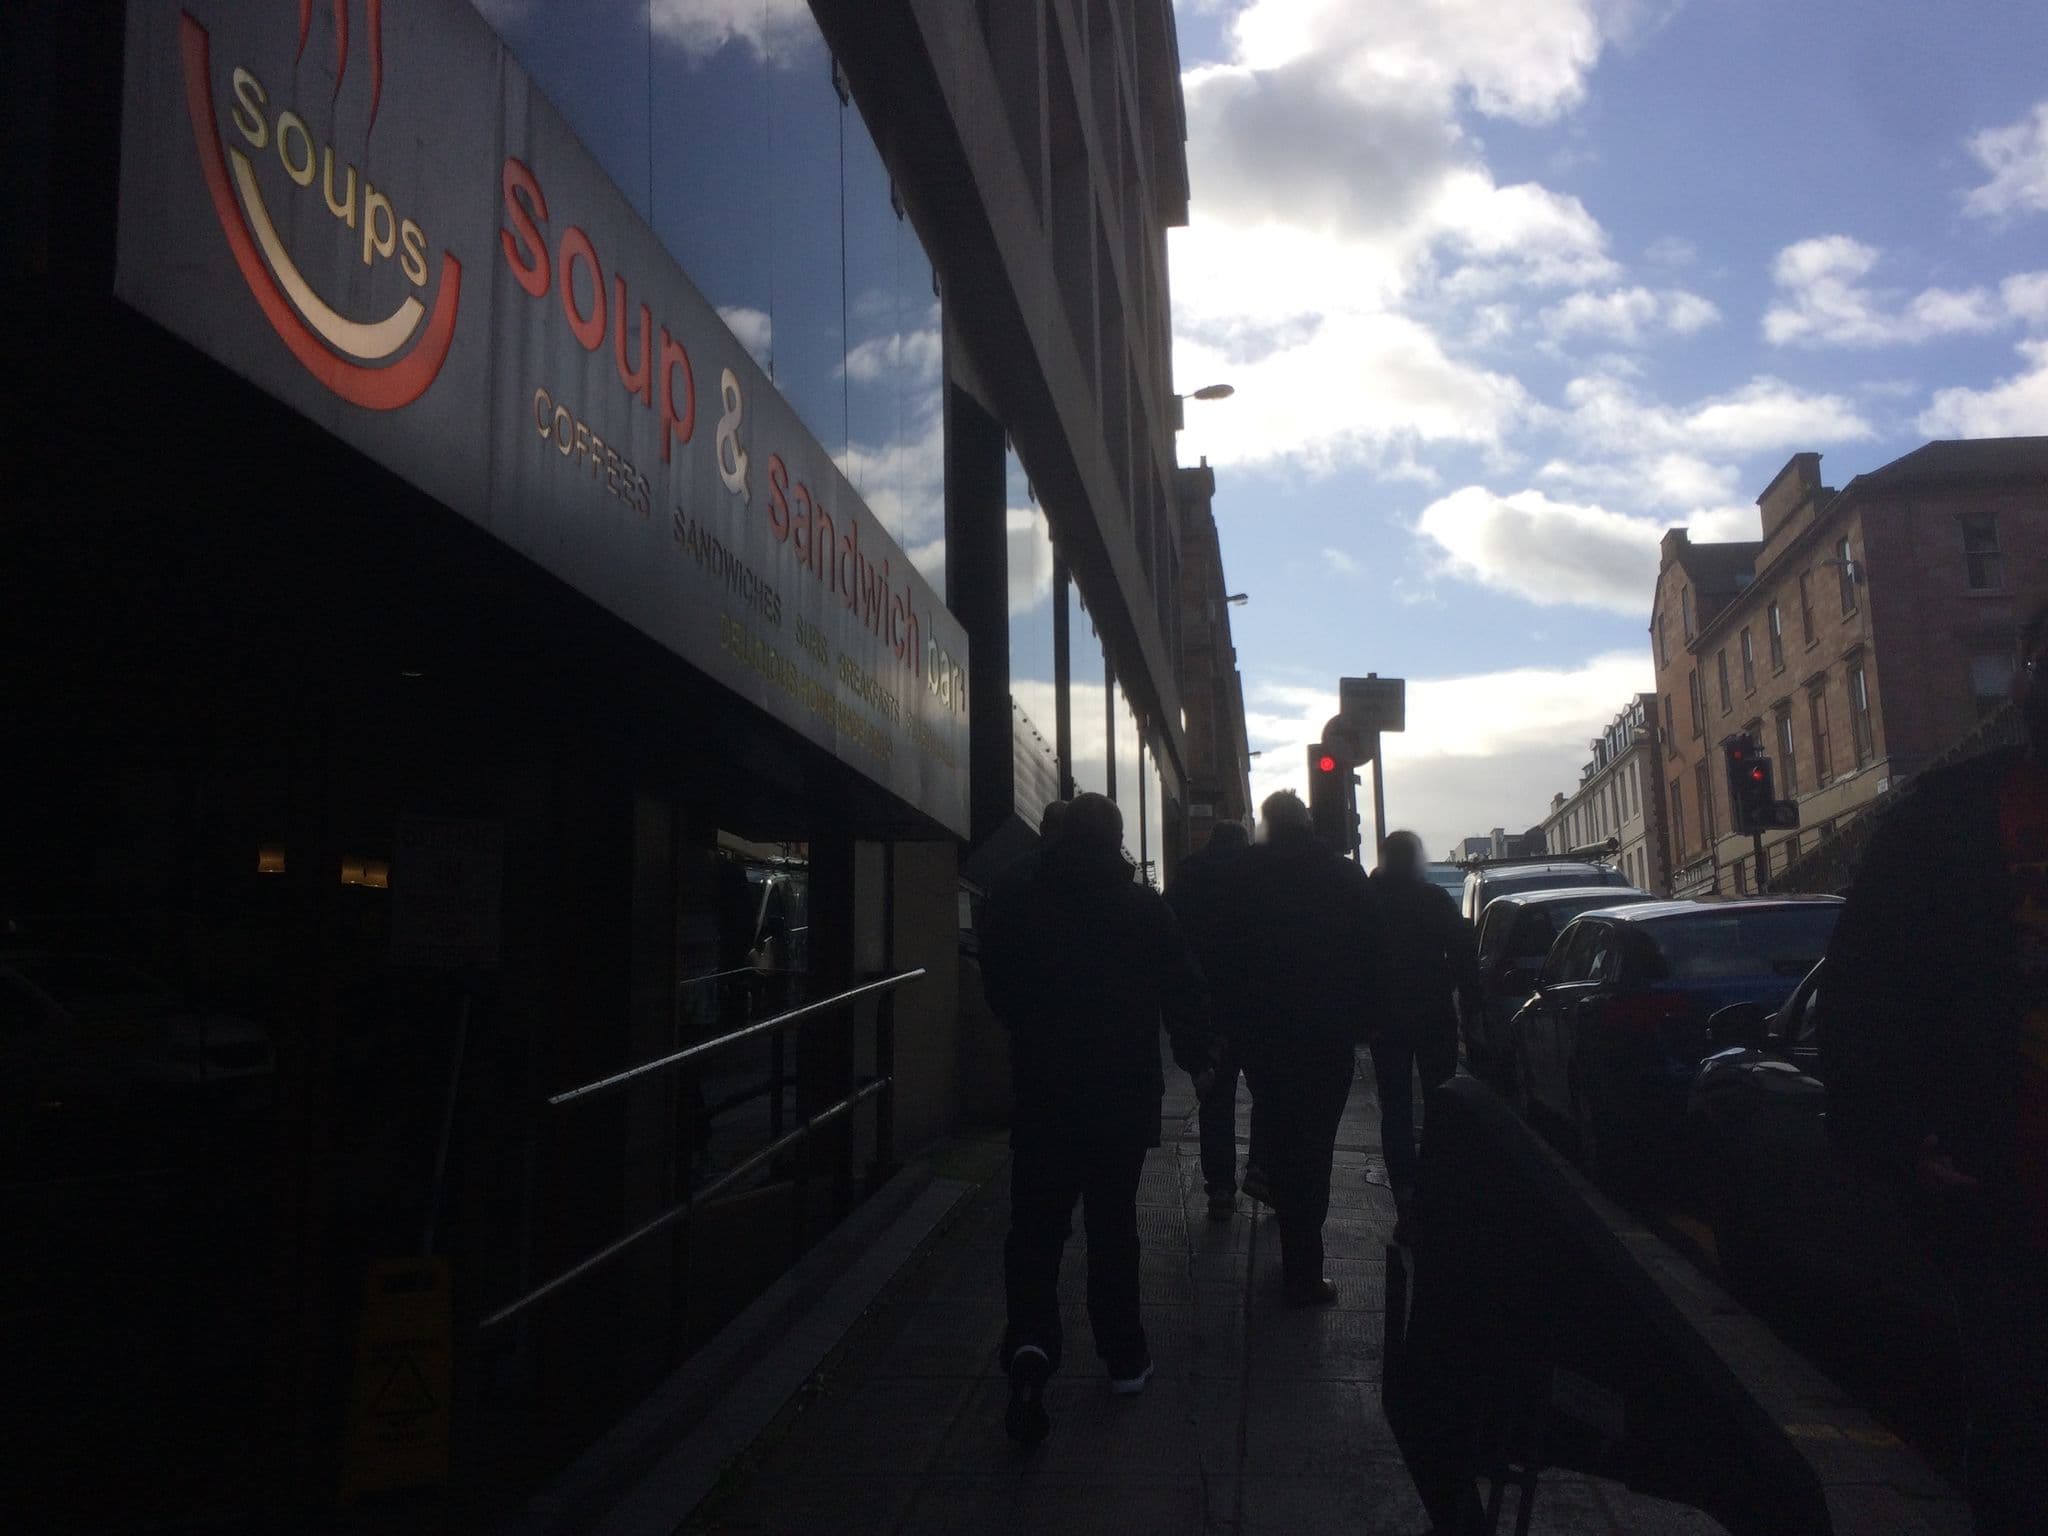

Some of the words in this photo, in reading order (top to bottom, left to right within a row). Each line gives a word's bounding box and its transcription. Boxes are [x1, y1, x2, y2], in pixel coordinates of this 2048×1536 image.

[232, 66, 428, 287] soups
[500, 156, 696, 465] soup
[716, 367, 751, 505] &
[767, 454, 920, 678] sandwich
[533, 386, 650, 513] COFFEES
[672, 505, 781, 627] SANDWICHES
